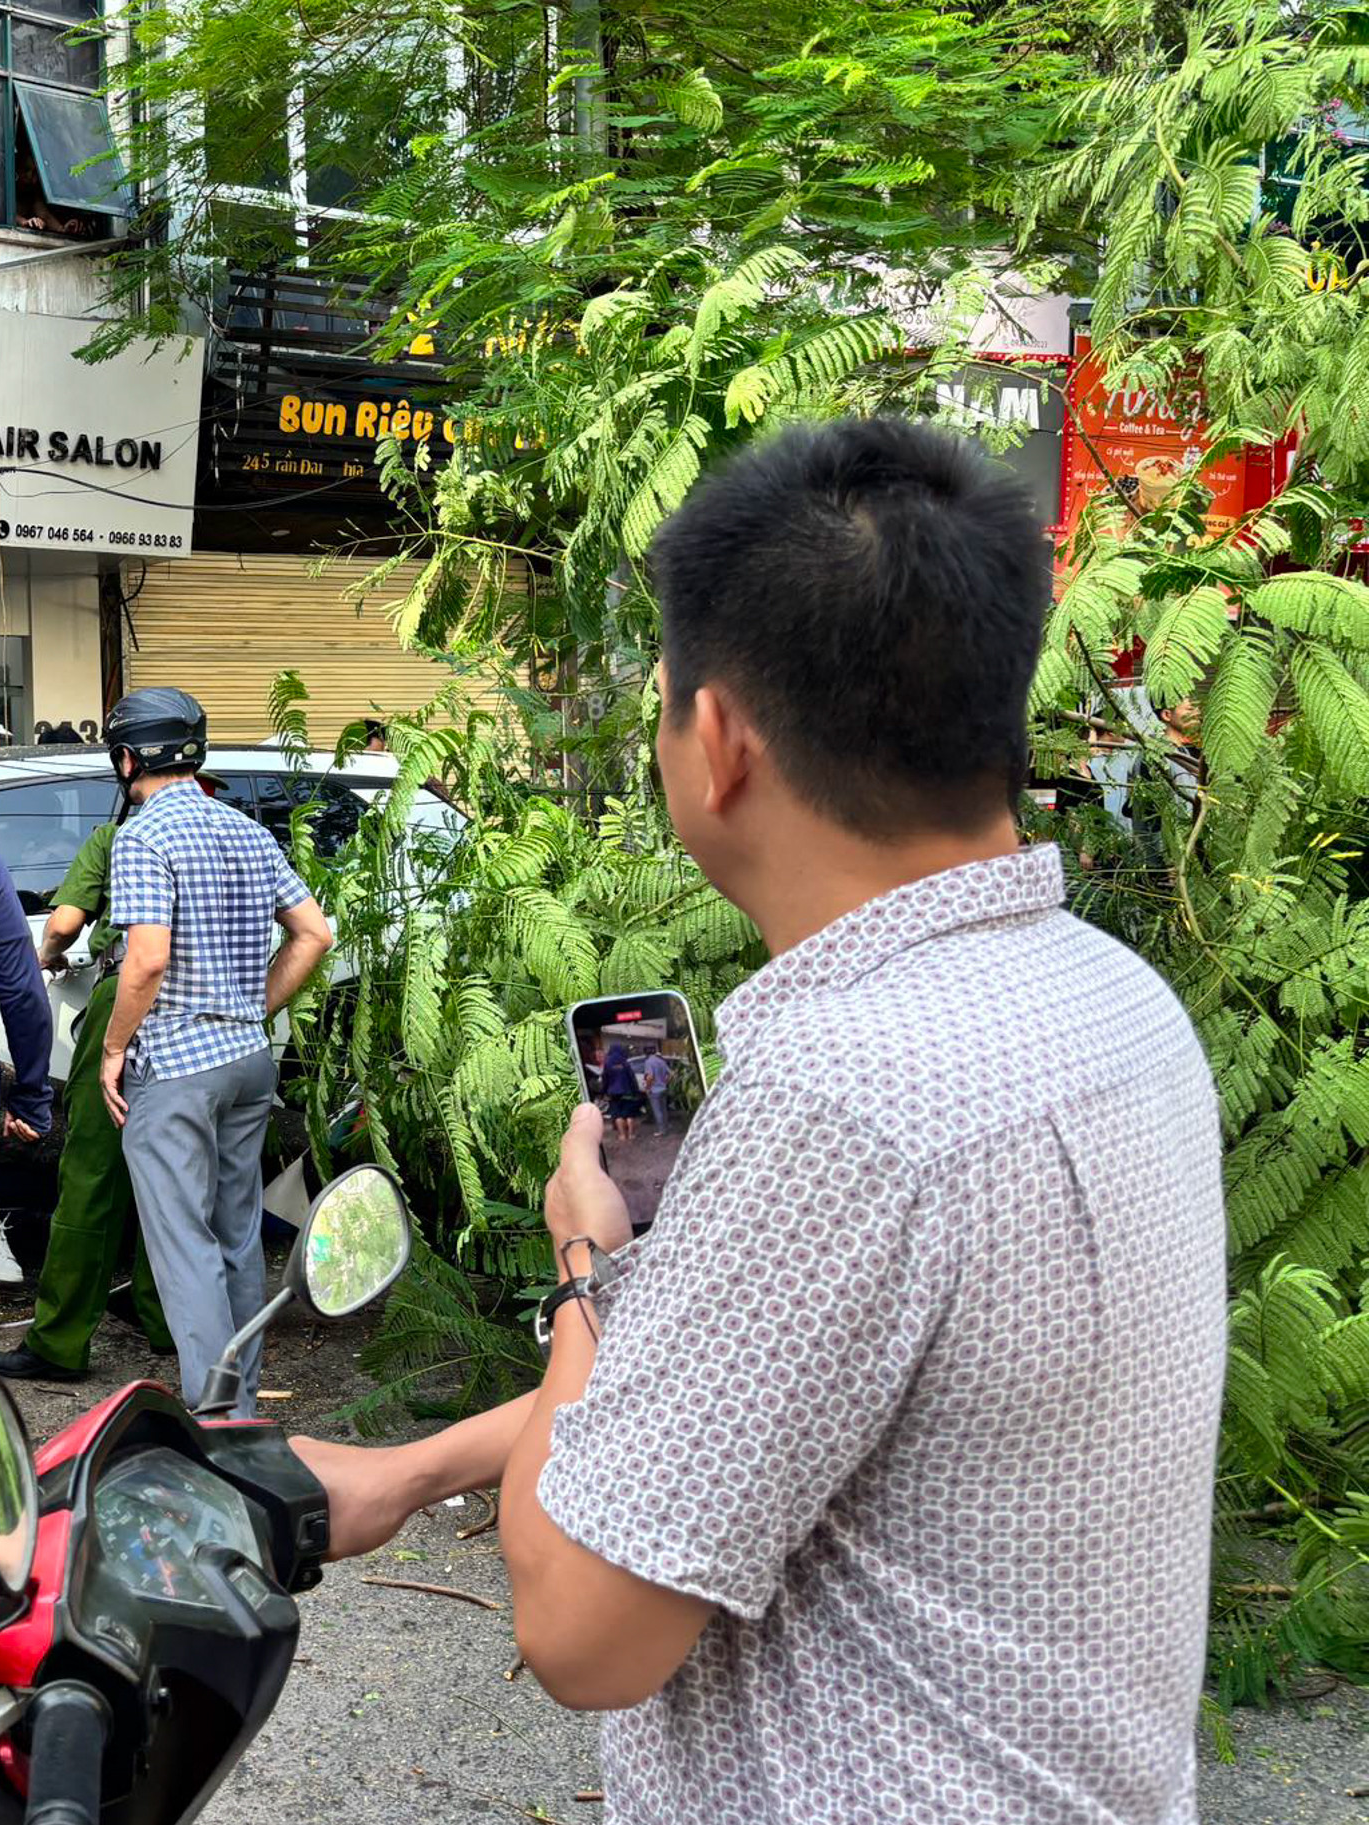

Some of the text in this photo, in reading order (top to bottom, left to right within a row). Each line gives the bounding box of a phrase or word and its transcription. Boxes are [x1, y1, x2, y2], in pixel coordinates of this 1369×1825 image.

[1119, 422, 1143, 434] Coffee
[47, 430, 163, 471] SALON
[242, 452, 270, 470] 245
[15, 524, 43, 538] 0967
[47, 527, 69, 541] 046
[72, 529, 94, 542] 564
[109, 531, 135, 545] 0966
[138, 533, 152, 546] 93
[154, 534, 167, 548] 83
[169, 536, 183, 549] 83
